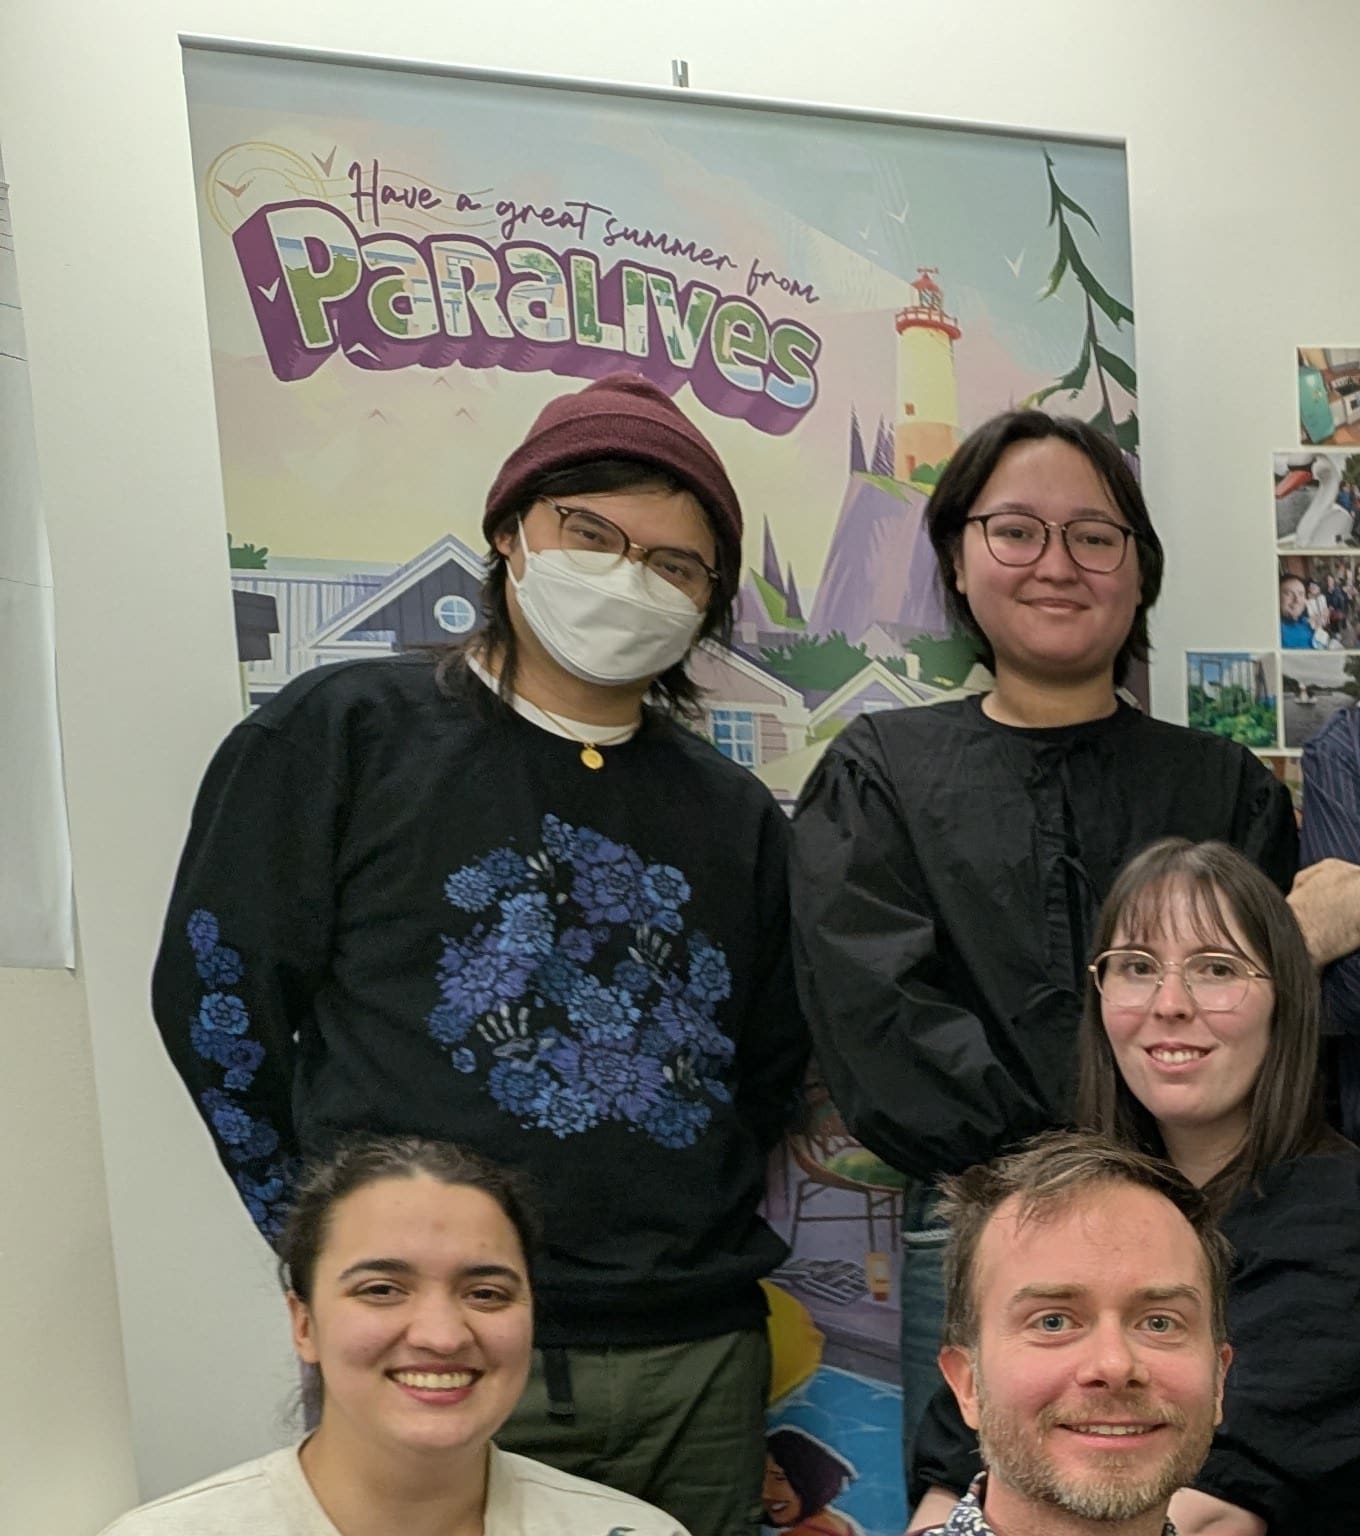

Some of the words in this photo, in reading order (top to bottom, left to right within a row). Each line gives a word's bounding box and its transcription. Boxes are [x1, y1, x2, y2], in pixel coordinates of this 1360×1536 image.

[350, 159, 442, 226] Have
[456, 191, 481, 212] a
[495, 201, 611, 240] great
[603, 218, 737, 271] summer
[747, 259, 820, 302] from
